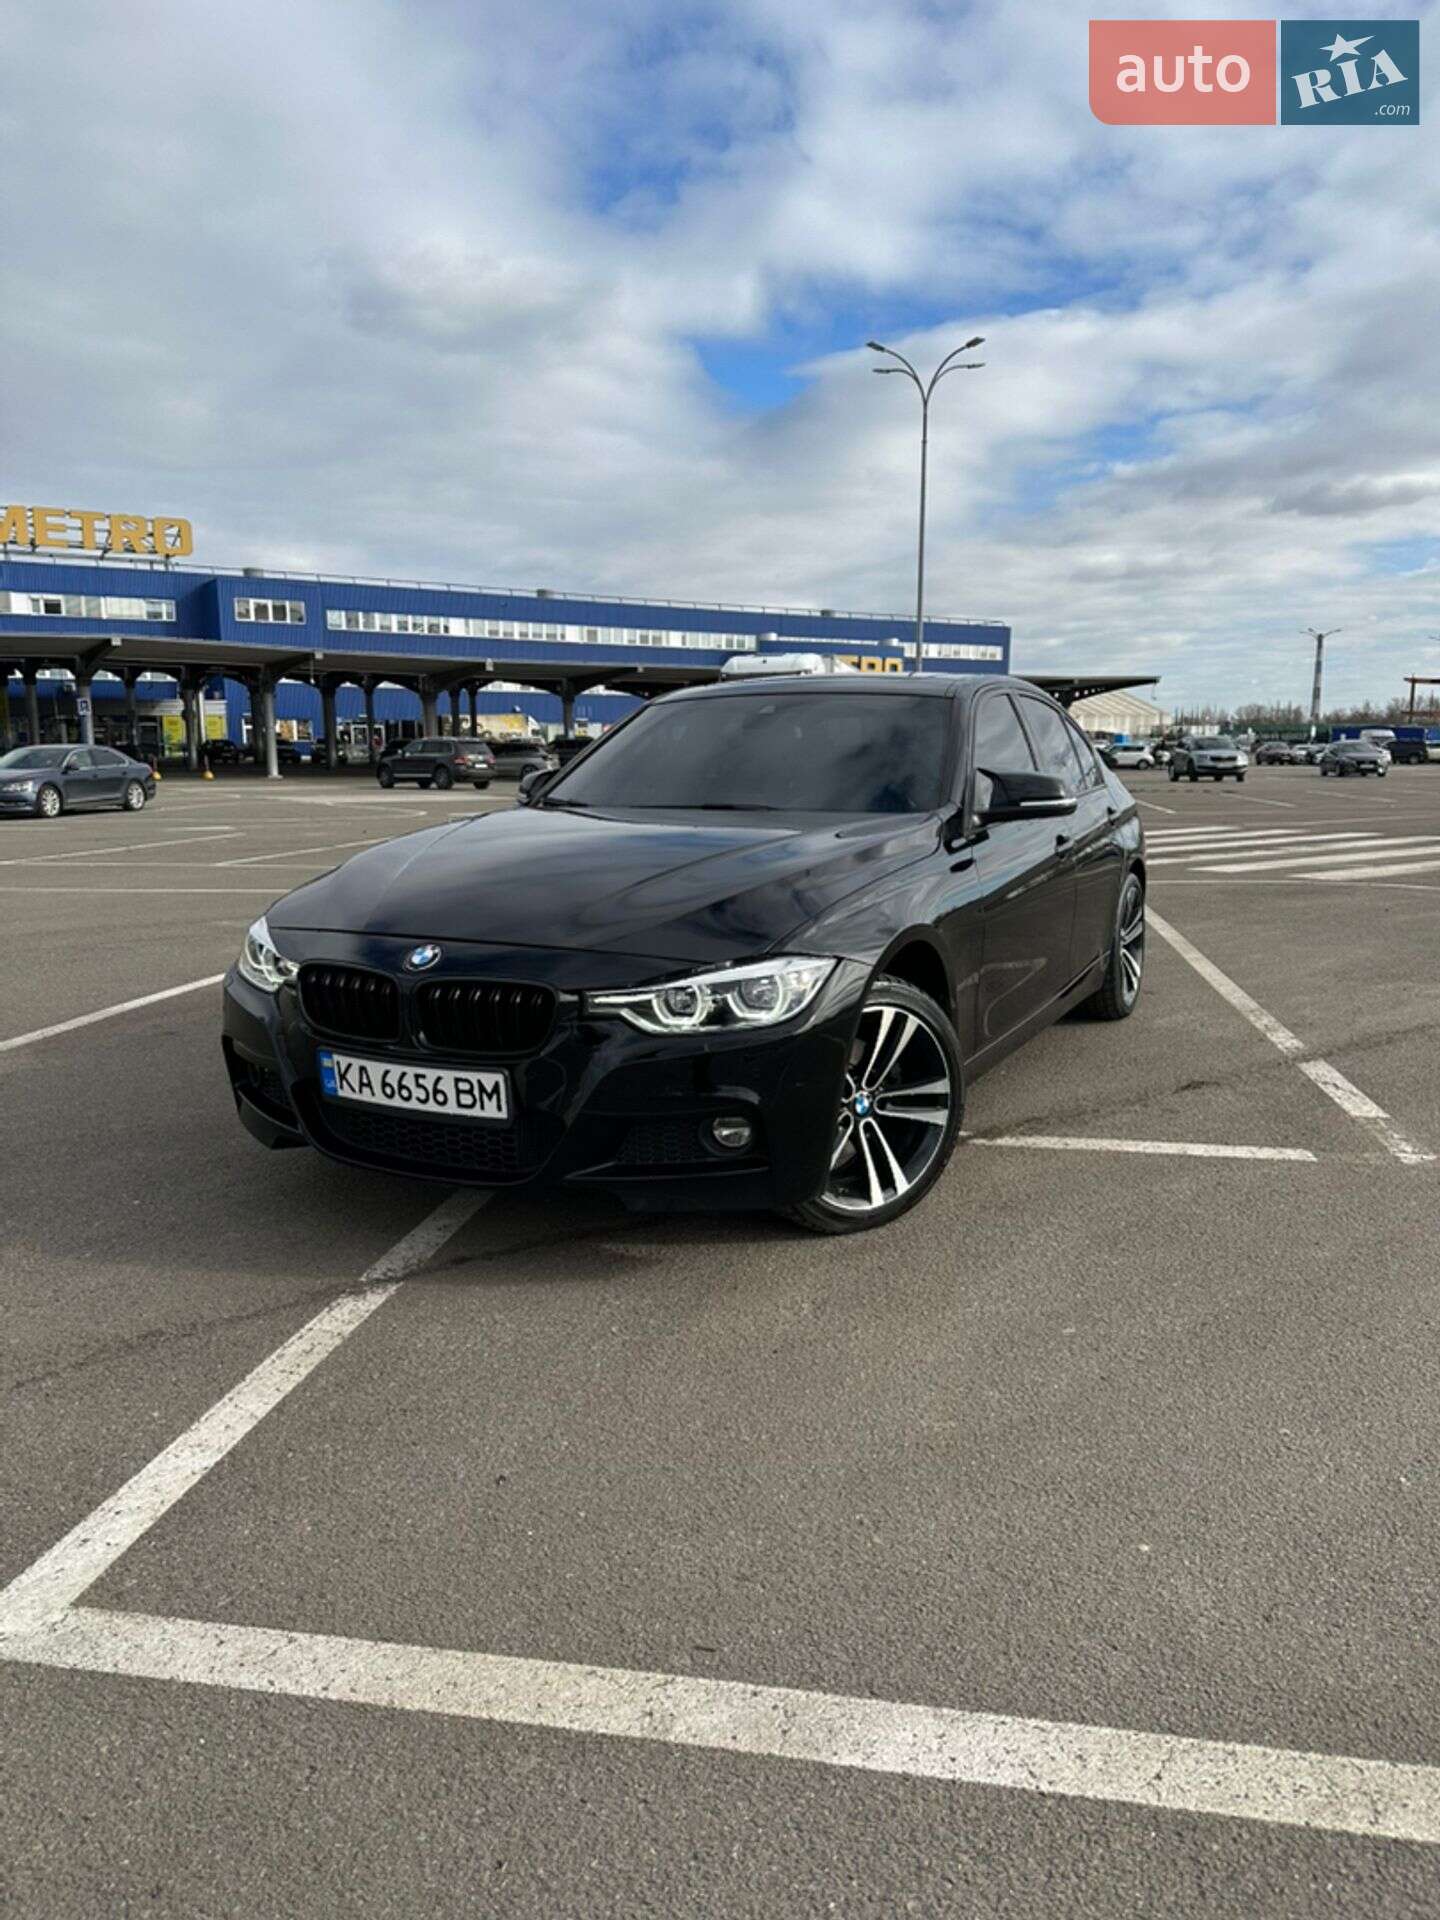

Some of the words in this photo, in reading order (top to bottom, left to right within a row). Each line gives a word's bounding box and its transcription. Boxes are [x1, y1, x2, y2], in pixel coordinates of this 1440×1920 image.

[335, 1060, 375, 1097] KA
[380, 1069, 449, 1107] 6656
[453, 1077, 504, 1113] BM
